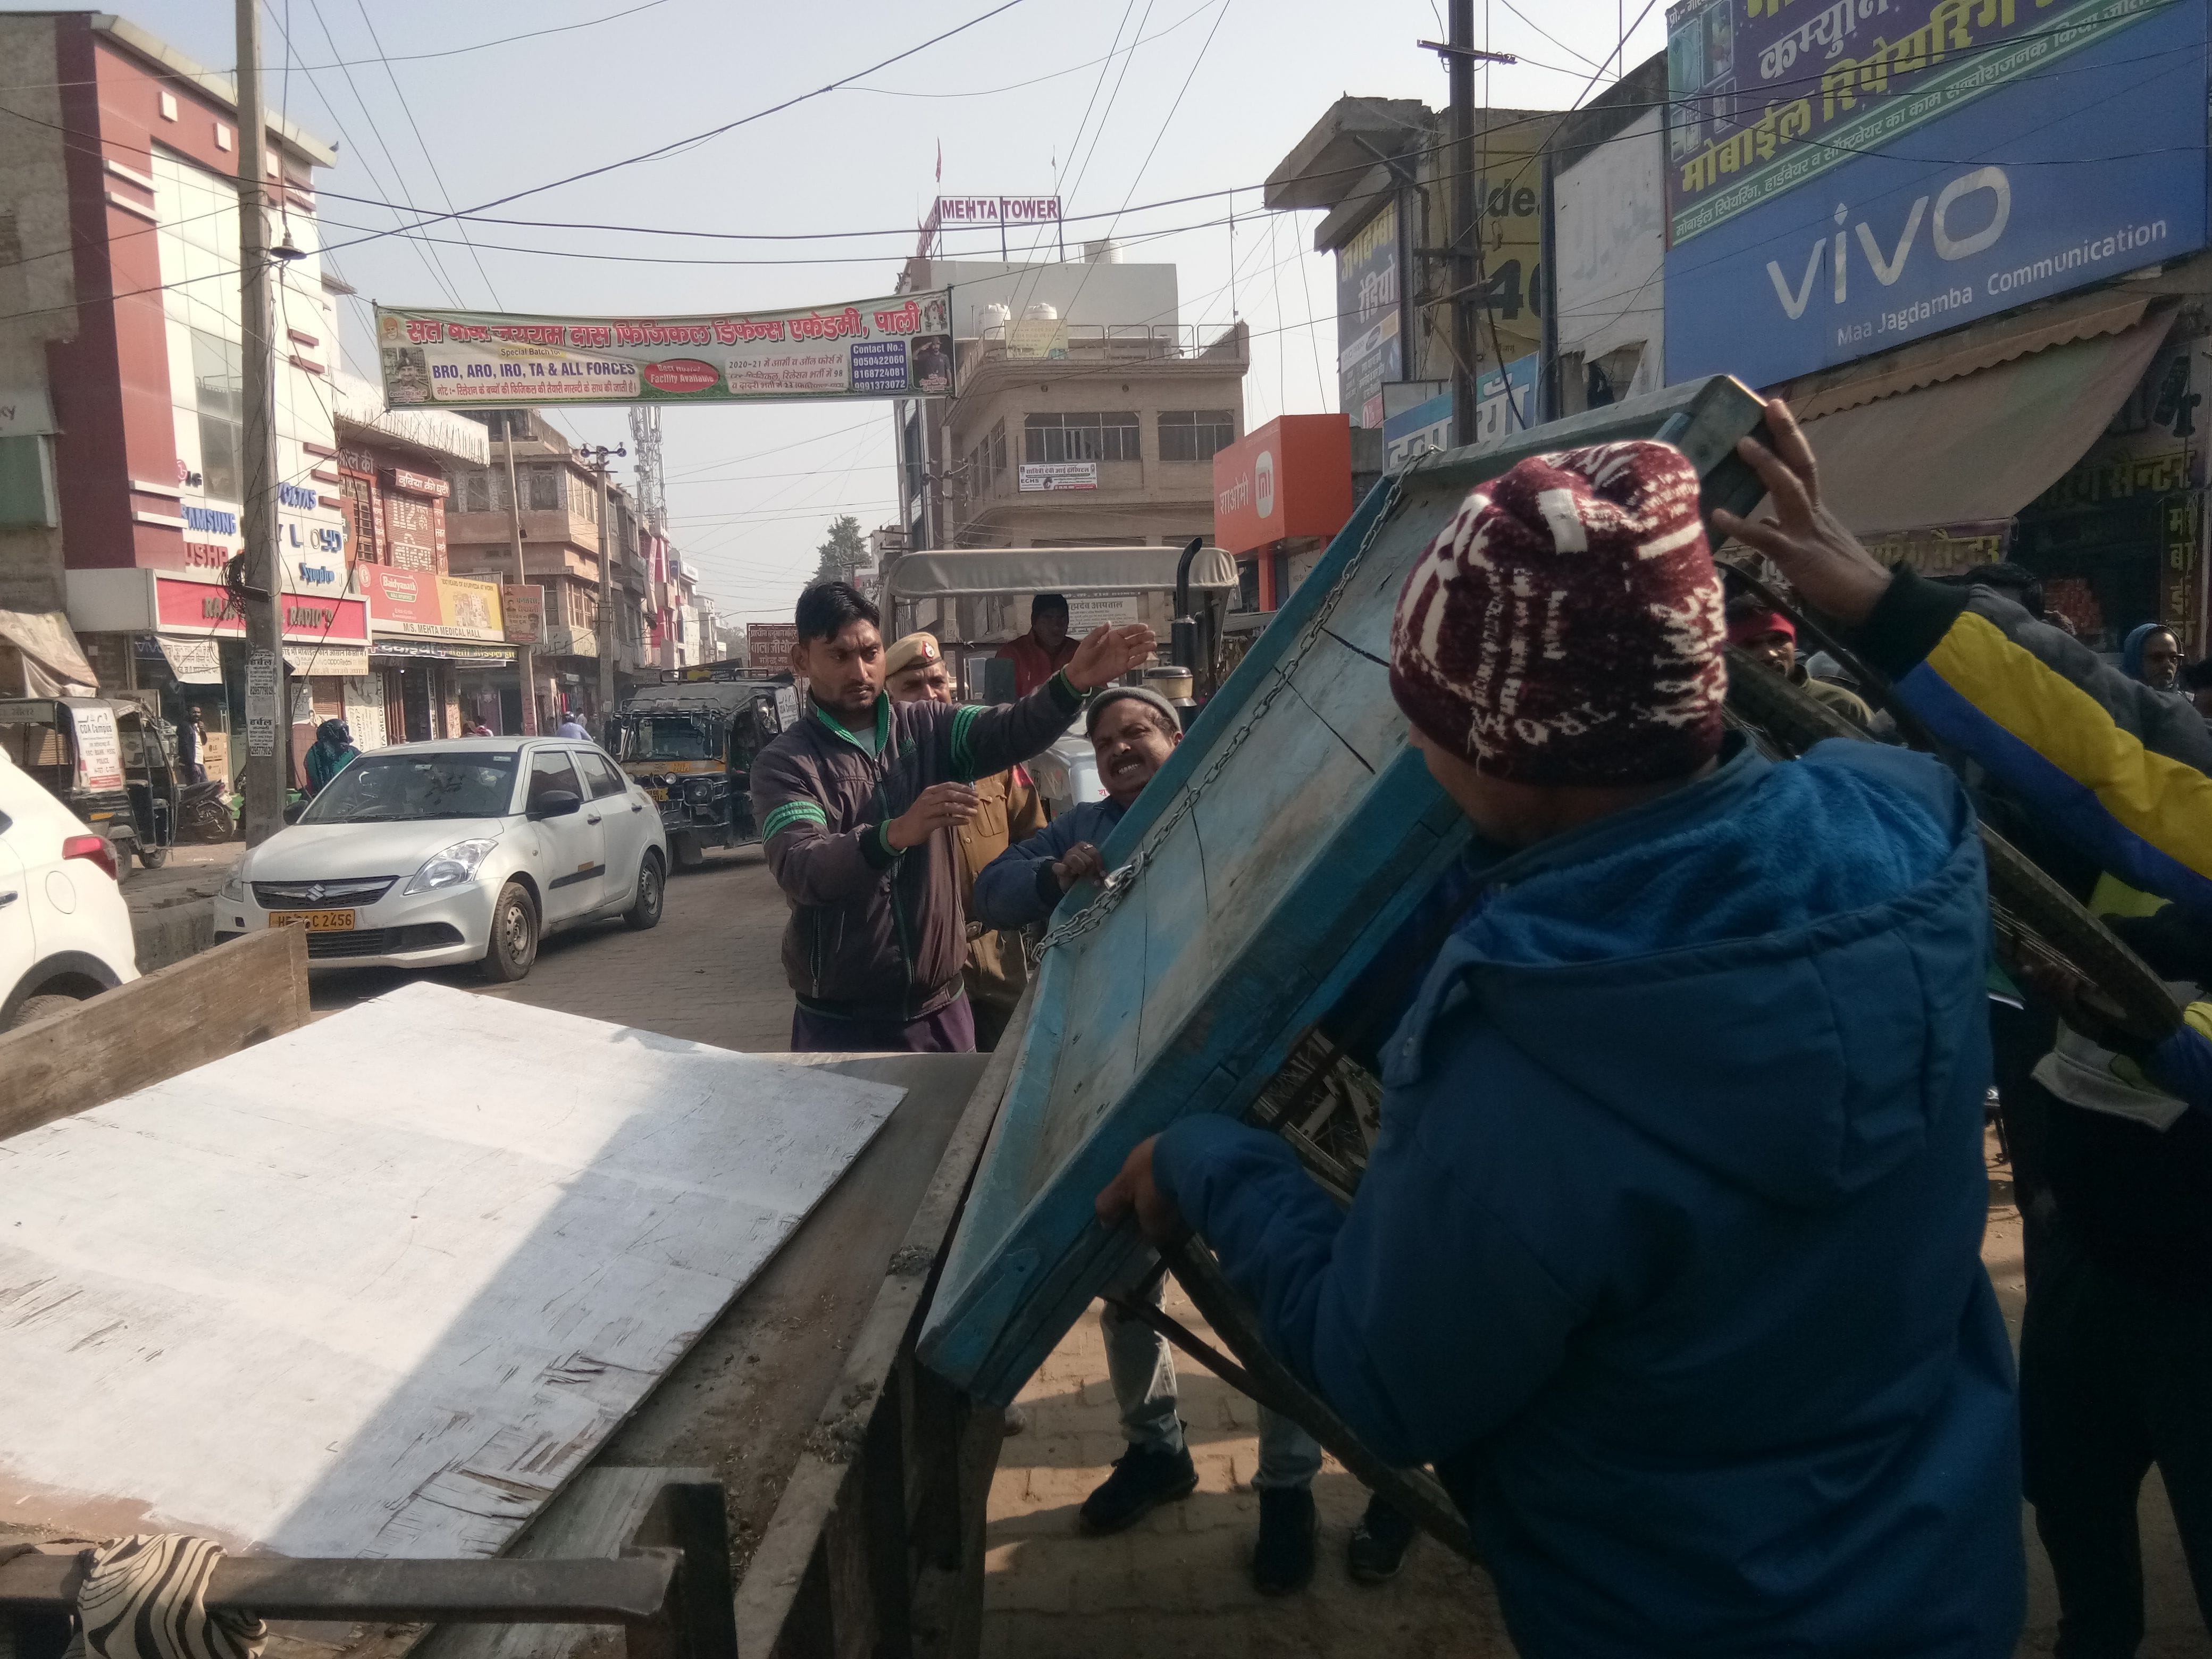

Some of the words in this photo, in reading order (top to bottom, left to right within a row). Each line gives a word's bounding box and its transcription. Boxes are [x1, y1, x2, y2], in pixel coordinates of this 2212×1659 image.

[1886, 109, 1905, 128] का
[1909, 90, 1941, 117] काम
[942, 199, 998, 219] MEHTA
[1002, 199, 1058, 219] TOWER
[1766, 166, 2012, 321] vivo
[1837, 320, 1873, 347] Maa
[1877, 284, 1973, 334] Jagdamba
[1987, 219, 2167, 296] Communication
[568, 325, 611, 347] दास
[613, 319, 711, 348] फिजिकल
[873, 299, 921, 336] पाली
[501, 348, 527, 358] Special
[853, 344, 884, 355] Contact
[853, 355, 904, 366] 9050422060
[432, 365, 464, 380] BRO,
[467, 364, 497, 379] ARO,
[500, 363, 526, 379] IRO,
[529, 362, 544, 376] TA
[548, 363, 557, 376] &
[562, 362, 583, 376] ALL
[586, 362, 635, 376] FORCES
[854, 367, 904, 379] 8168724081
[651, 374, 677, 384] Facility
[854, 380, 906, 390] 9991373072
[479, 383, 484, 395] के
[501, 382, 509, 395] की
[510, 382, 537, 395] फिजिकल
[538, 381, 546, 394] की
[547, 381, 563, 394] तैयारी
[584, 381, 590, 392] के
[604, 380, 611, 393] की
[613, 381, 627, 393] जाती
[181, 504, 237, 537] SAMSUNG
[382, 576, 417, 592] Baidyanath
[403, 623, 417, 633] M/S.
[418, 624, 439, 635] MEHTA
[440, 626, 466, 638] MEDICAL
[467, 629, 481, 638] HALL
[377, 684, 386, 732] MEDICAL
[92, 723, 113, 734] Campus
[322, 914, 351, 927] 2456
